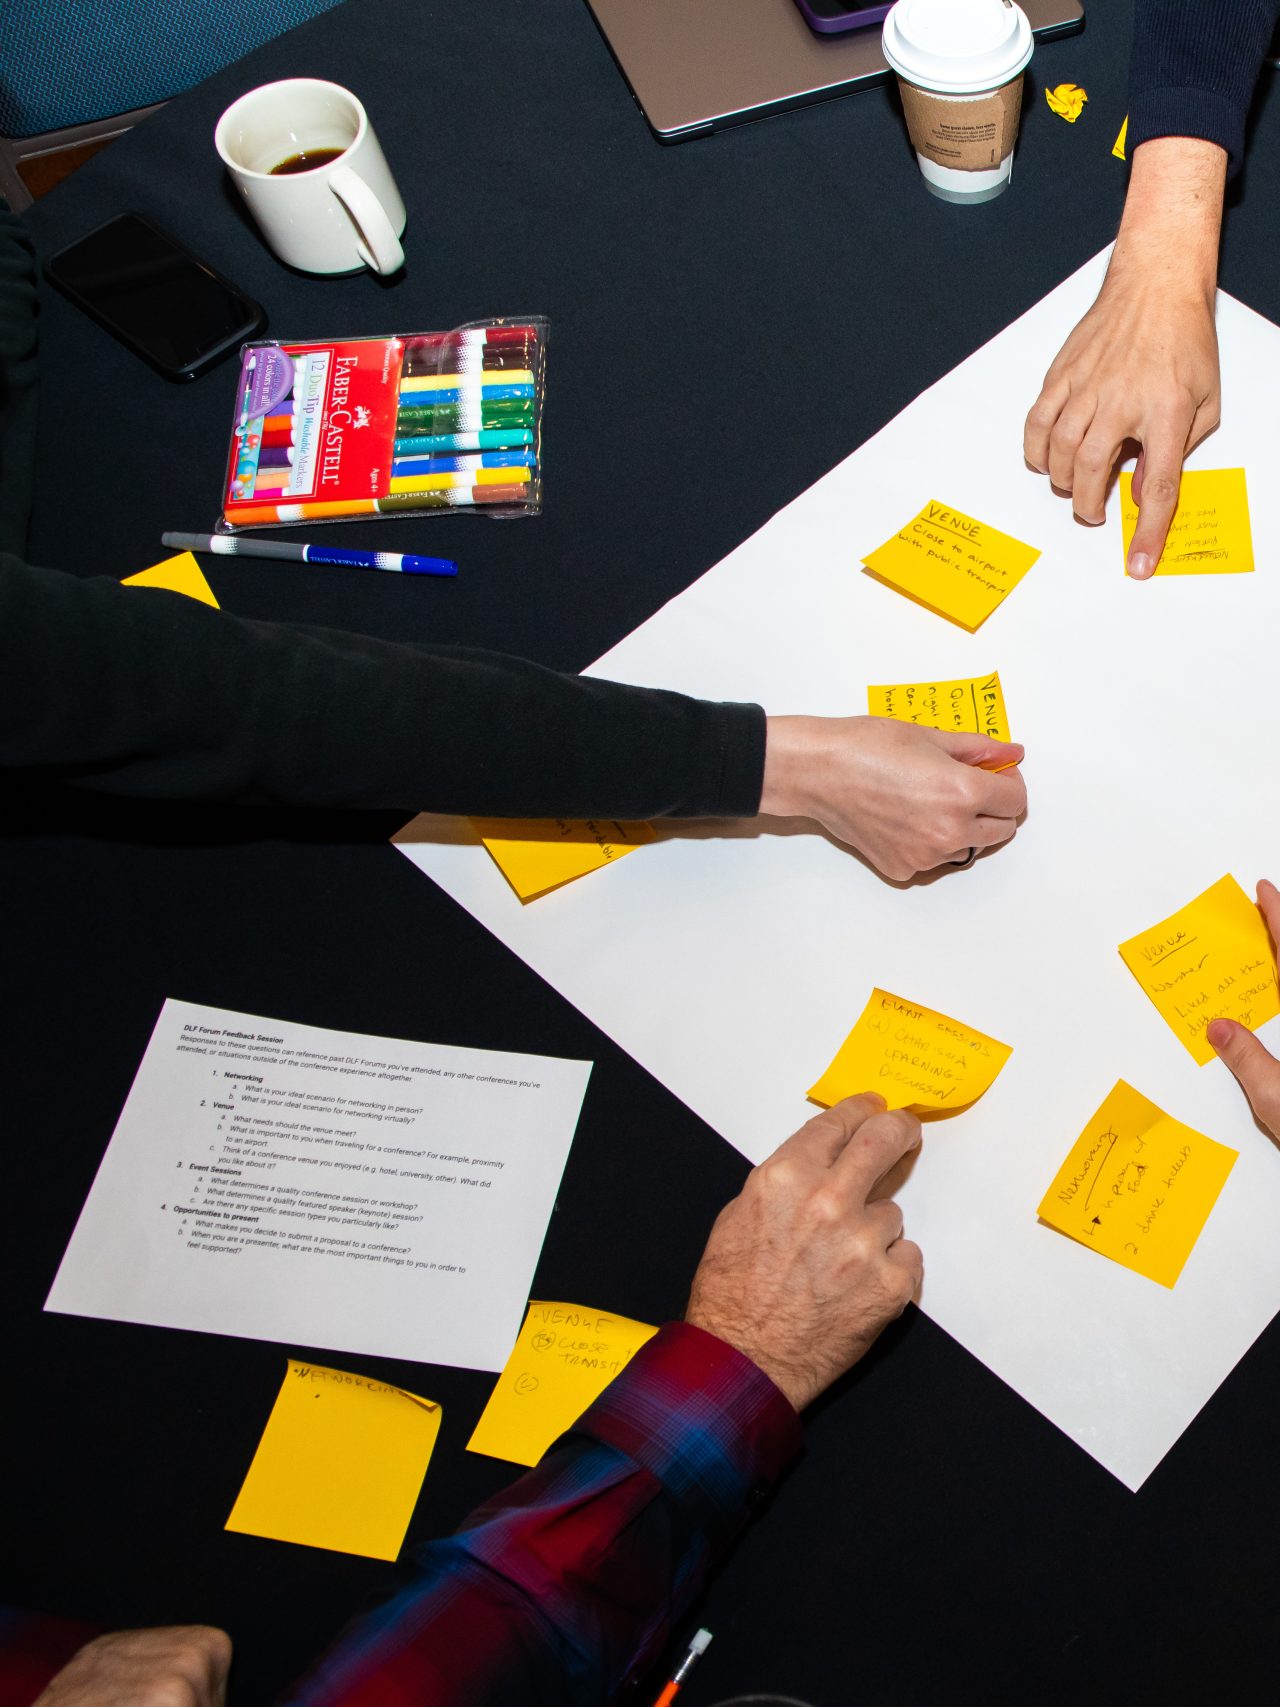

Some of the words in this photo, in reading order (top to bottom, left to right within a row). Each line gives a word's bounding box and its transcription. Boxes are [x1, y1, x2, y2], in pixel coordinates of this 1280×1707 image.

[264, 365, 274, 386] colors
[311, 359, 325, 371] 12
[261, 395, 271, 407] all!
[299, 417, 314, 455] Washable
[296, 455, 310, 489] Markers
[370, 467, 380, 484] Ages
[928, 504, 980, 538] VENUE
[898, 533, 923, 549] with
[926, 549, 960, 571] public
[912, 524, 945, 546] Close
[951, 544, 962, 554] to
[968, 554, 1008, 577] airport
[906, 687, 916, 707] can
[923, 686, 940, 716] night
[980, 677, 1000, 737] VENUE
[1140, 931, 1187, 962] Venue
[1174, 991, 1211, 1019] Liked
[182, 1023, 199, 1032] DLF
[197, 1026, 222, 1036] Forum
[221, 1029, 256, 1041] Feedback
[255, 1033, 284, 1044] Session
[179, 1033, 218, 1046] Responses
[226, 1040, 247, 1050] these
[246, 1044, 281, 1054] questions
[280, 1048, 295, 1056] can
[294, 1049, 329, 1061] reference
[327, 1055, 345, 1063] past
[344, 1056, 360, 1065] DLF
[359, 1058, 387, 1069] Forums
[442, 1070, 457, 1079] any
[455, 1072, 476, 1080] other
[475, 1075, 518, 1086] conferences
[222, 1070, 264, 1084] Networking
[212, 1100, 235, 1111] Venue
[244, 1084, 263, 1093] What
[287, 1090, 306, 1099] ideal
[305, 1093, 336, 1103] scenario
[335, 1096, 348, 1105] for
[346, 1099, 387, 1112] networking
[393, 1105, 424, 1115] person?
[232, 1114, 252, 1124] What
[251, 1118, 274, 1127] needs
[274, 1120, 300, 1130] should
[299, 1123, 312, 1132] the
[311, 1126, 334, 1135] venue
[333, 1129, 357, 1138] meet?
[188, 1162, 210, 1172] Event
[209, 1165, 242, 1177] Sessions
[172, 1204, 222, 1218] Opportunities
[222, 1211, 231, 1220] to
[230, 1213, 260, 1223] present
[1124, 1241, 1139, 1256] 2
[1139, 1198, 1166, 1234] drink
[185, 1240, 201, 1249] feel
[200, 1243, 243, 1255] supported?
